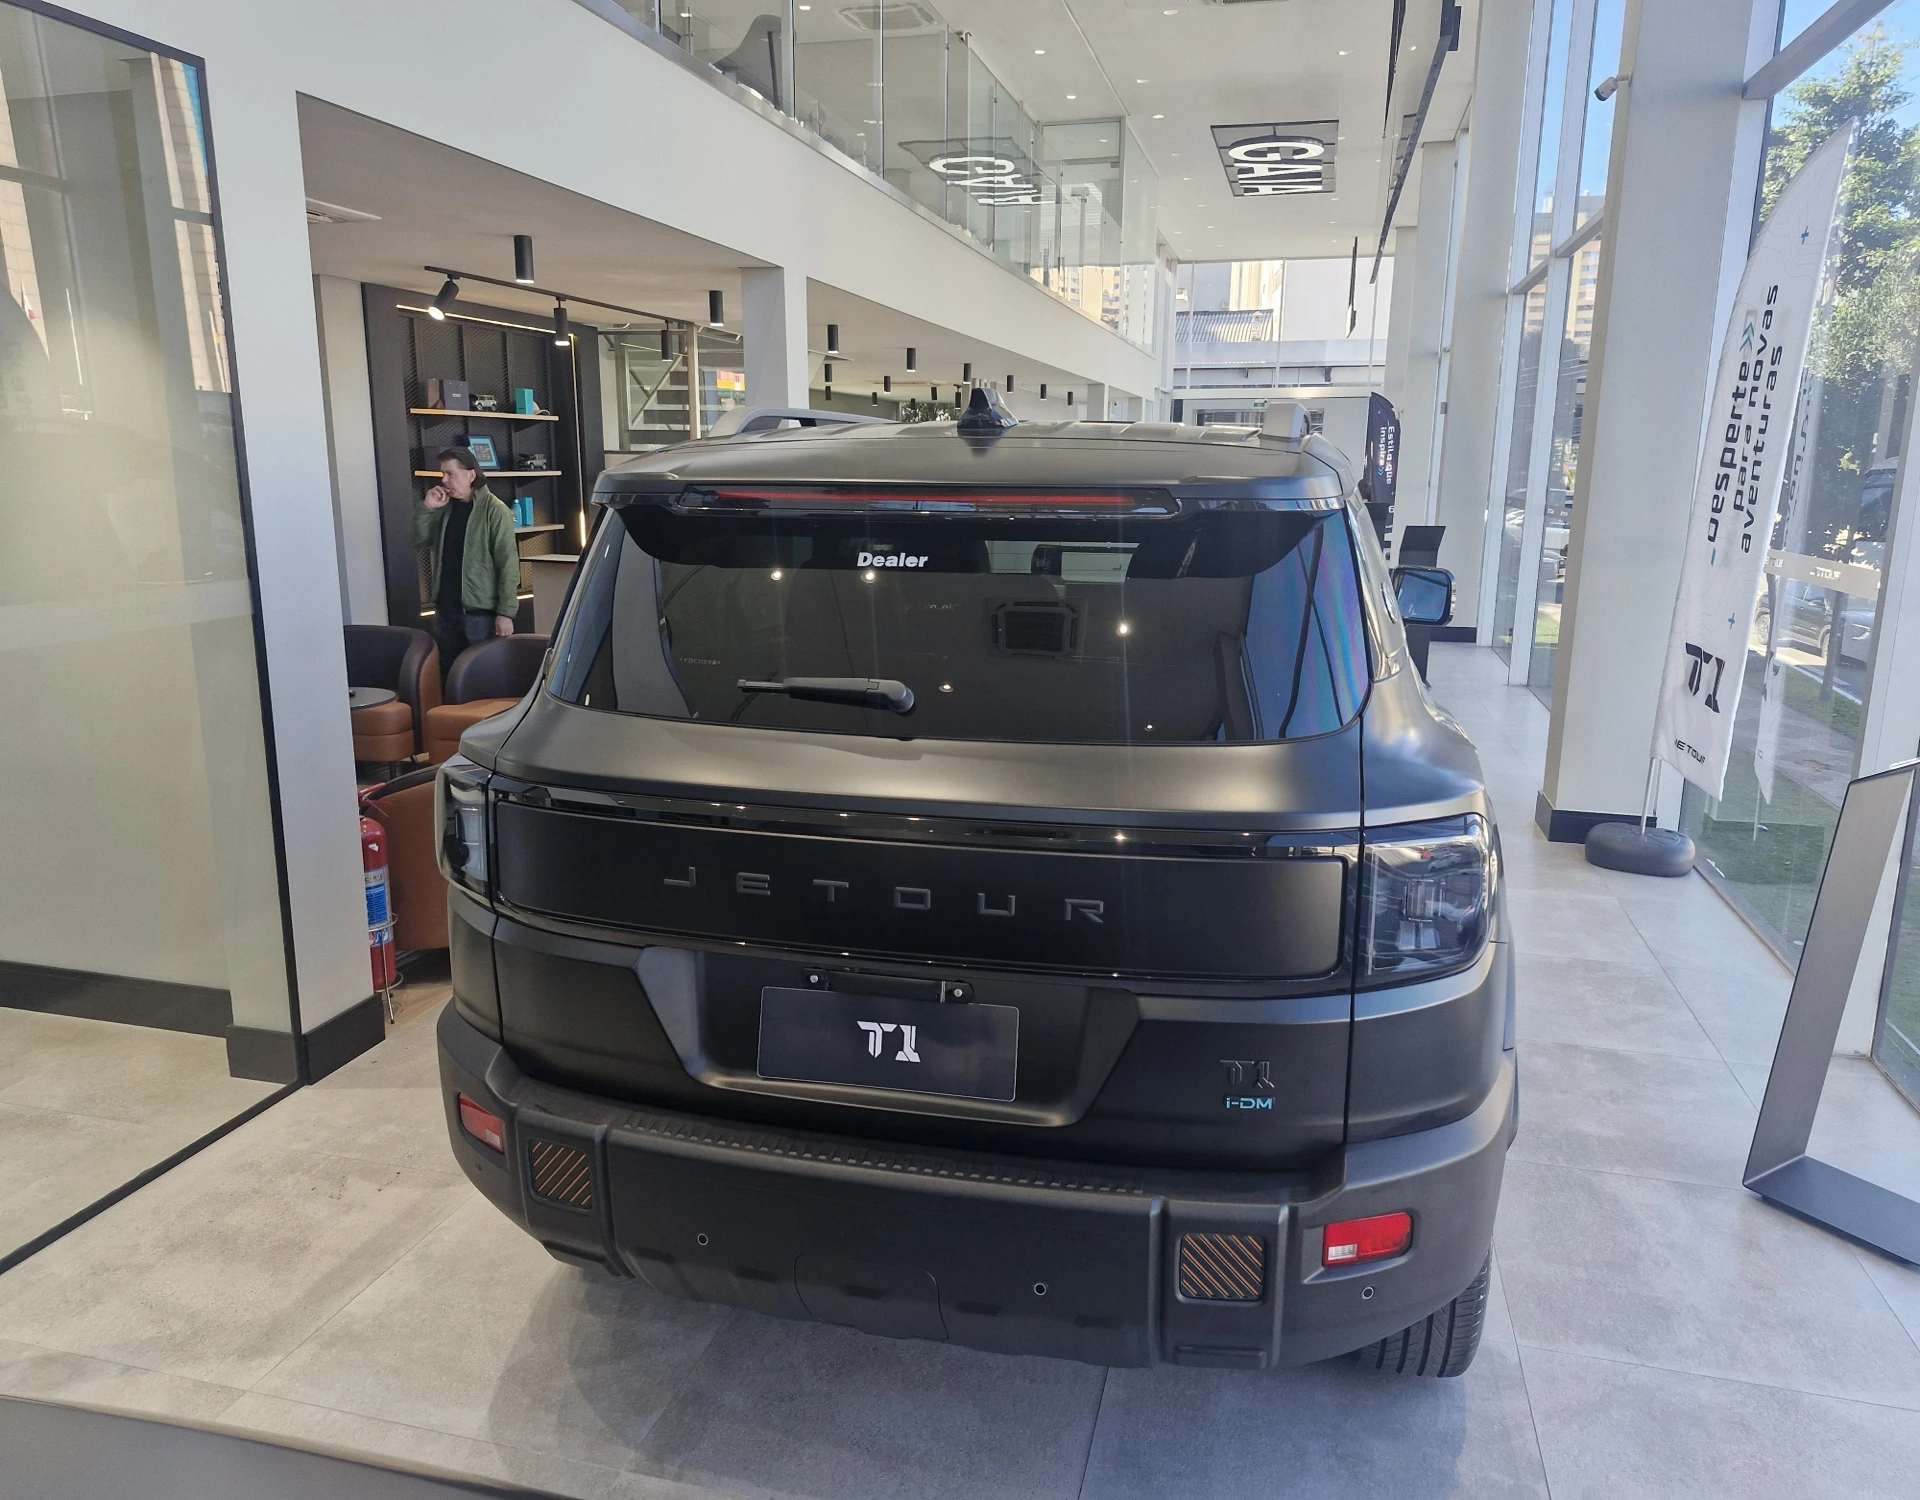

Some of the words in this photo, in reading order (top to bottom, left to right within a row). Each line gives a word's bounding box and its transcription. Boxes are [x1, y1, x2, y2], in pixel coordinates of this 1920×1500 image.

[1228, 140, 1325, 196] GAIA
[1733, 424, 1752, 512] para
[1748, 284, 1779, 407] novas
[1379, 426, 1387, 466] inspira
[1741, 345, 1783, 554] aventuras
[856, 552, 928, 568] Dealer
[1685, 642, 1725, 713] T1
[664, 866, 1104, 923] JETOUR
[856, 1020, 921, 1063] T1
[1219, 1059, 1275, 1088] T1
[1226, 1097, 1273, 1110] i-DM
